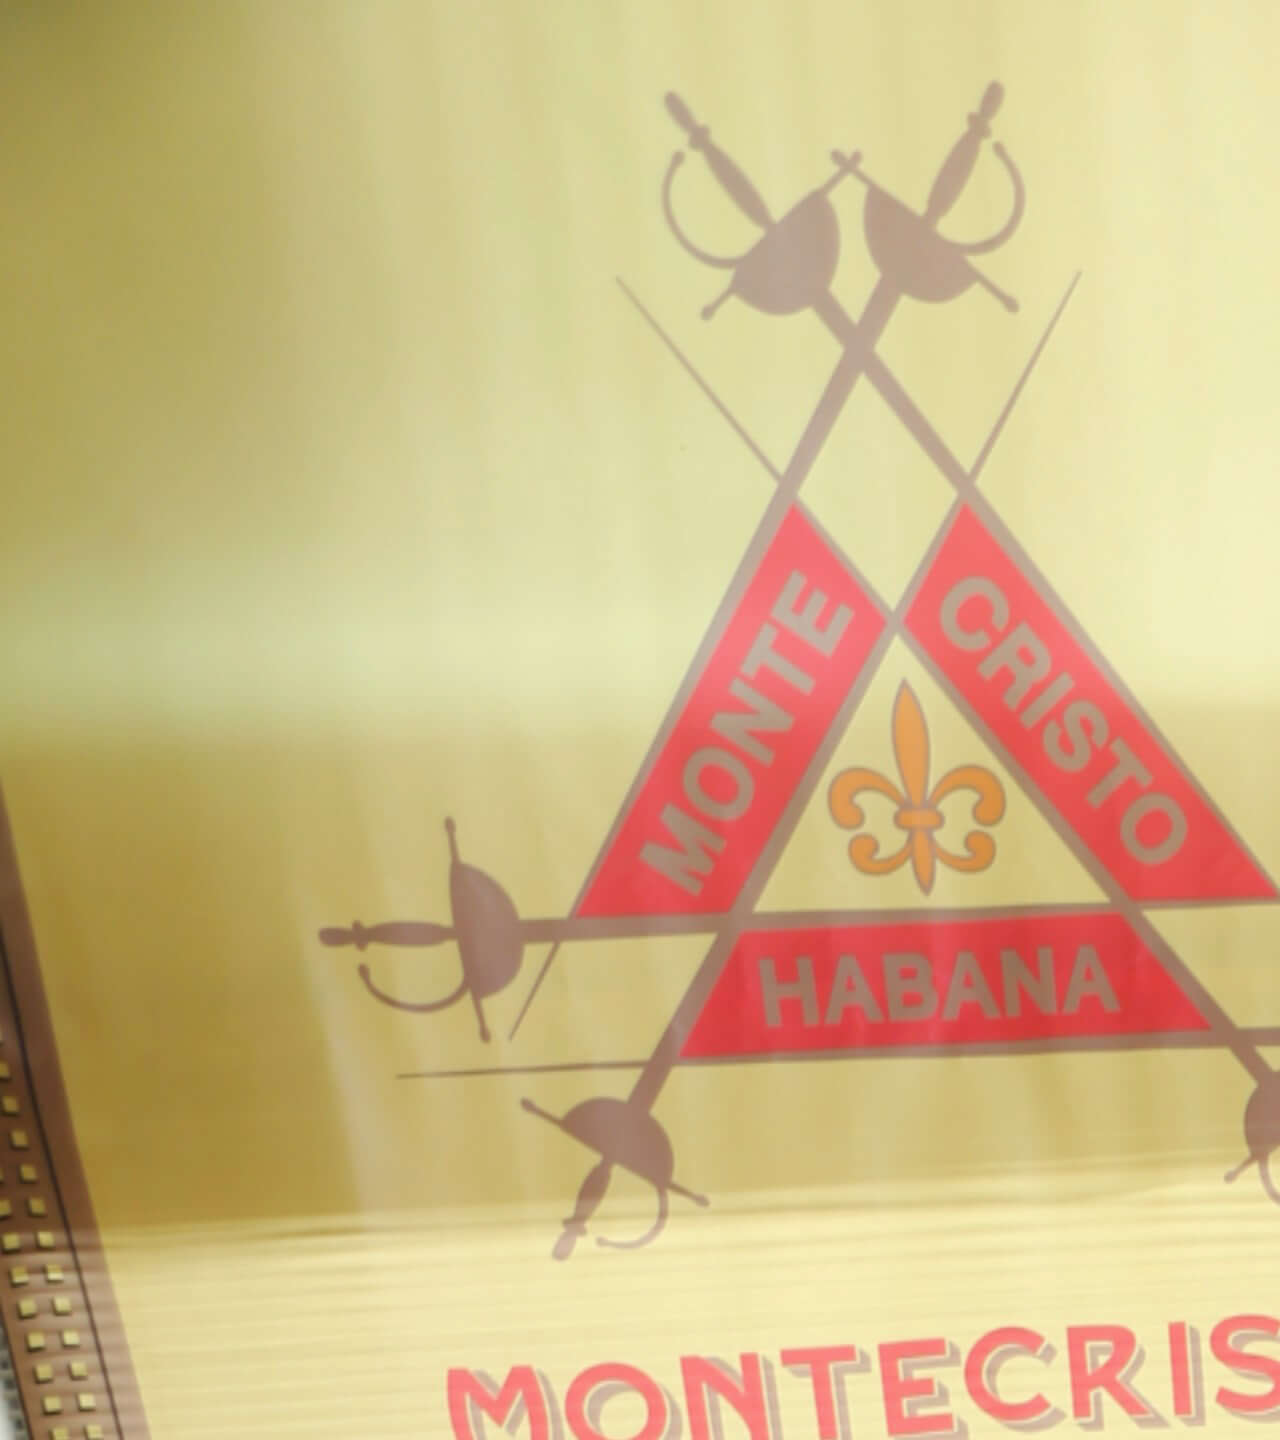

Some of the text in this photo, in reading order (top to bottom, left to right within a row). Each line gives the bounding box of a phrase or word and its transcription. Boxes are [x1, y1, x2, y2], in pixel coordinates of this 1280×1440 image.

[635, 569, 1189, 896] MONTE CRISTO
[757, 943, 1121, 1028] HABANA
